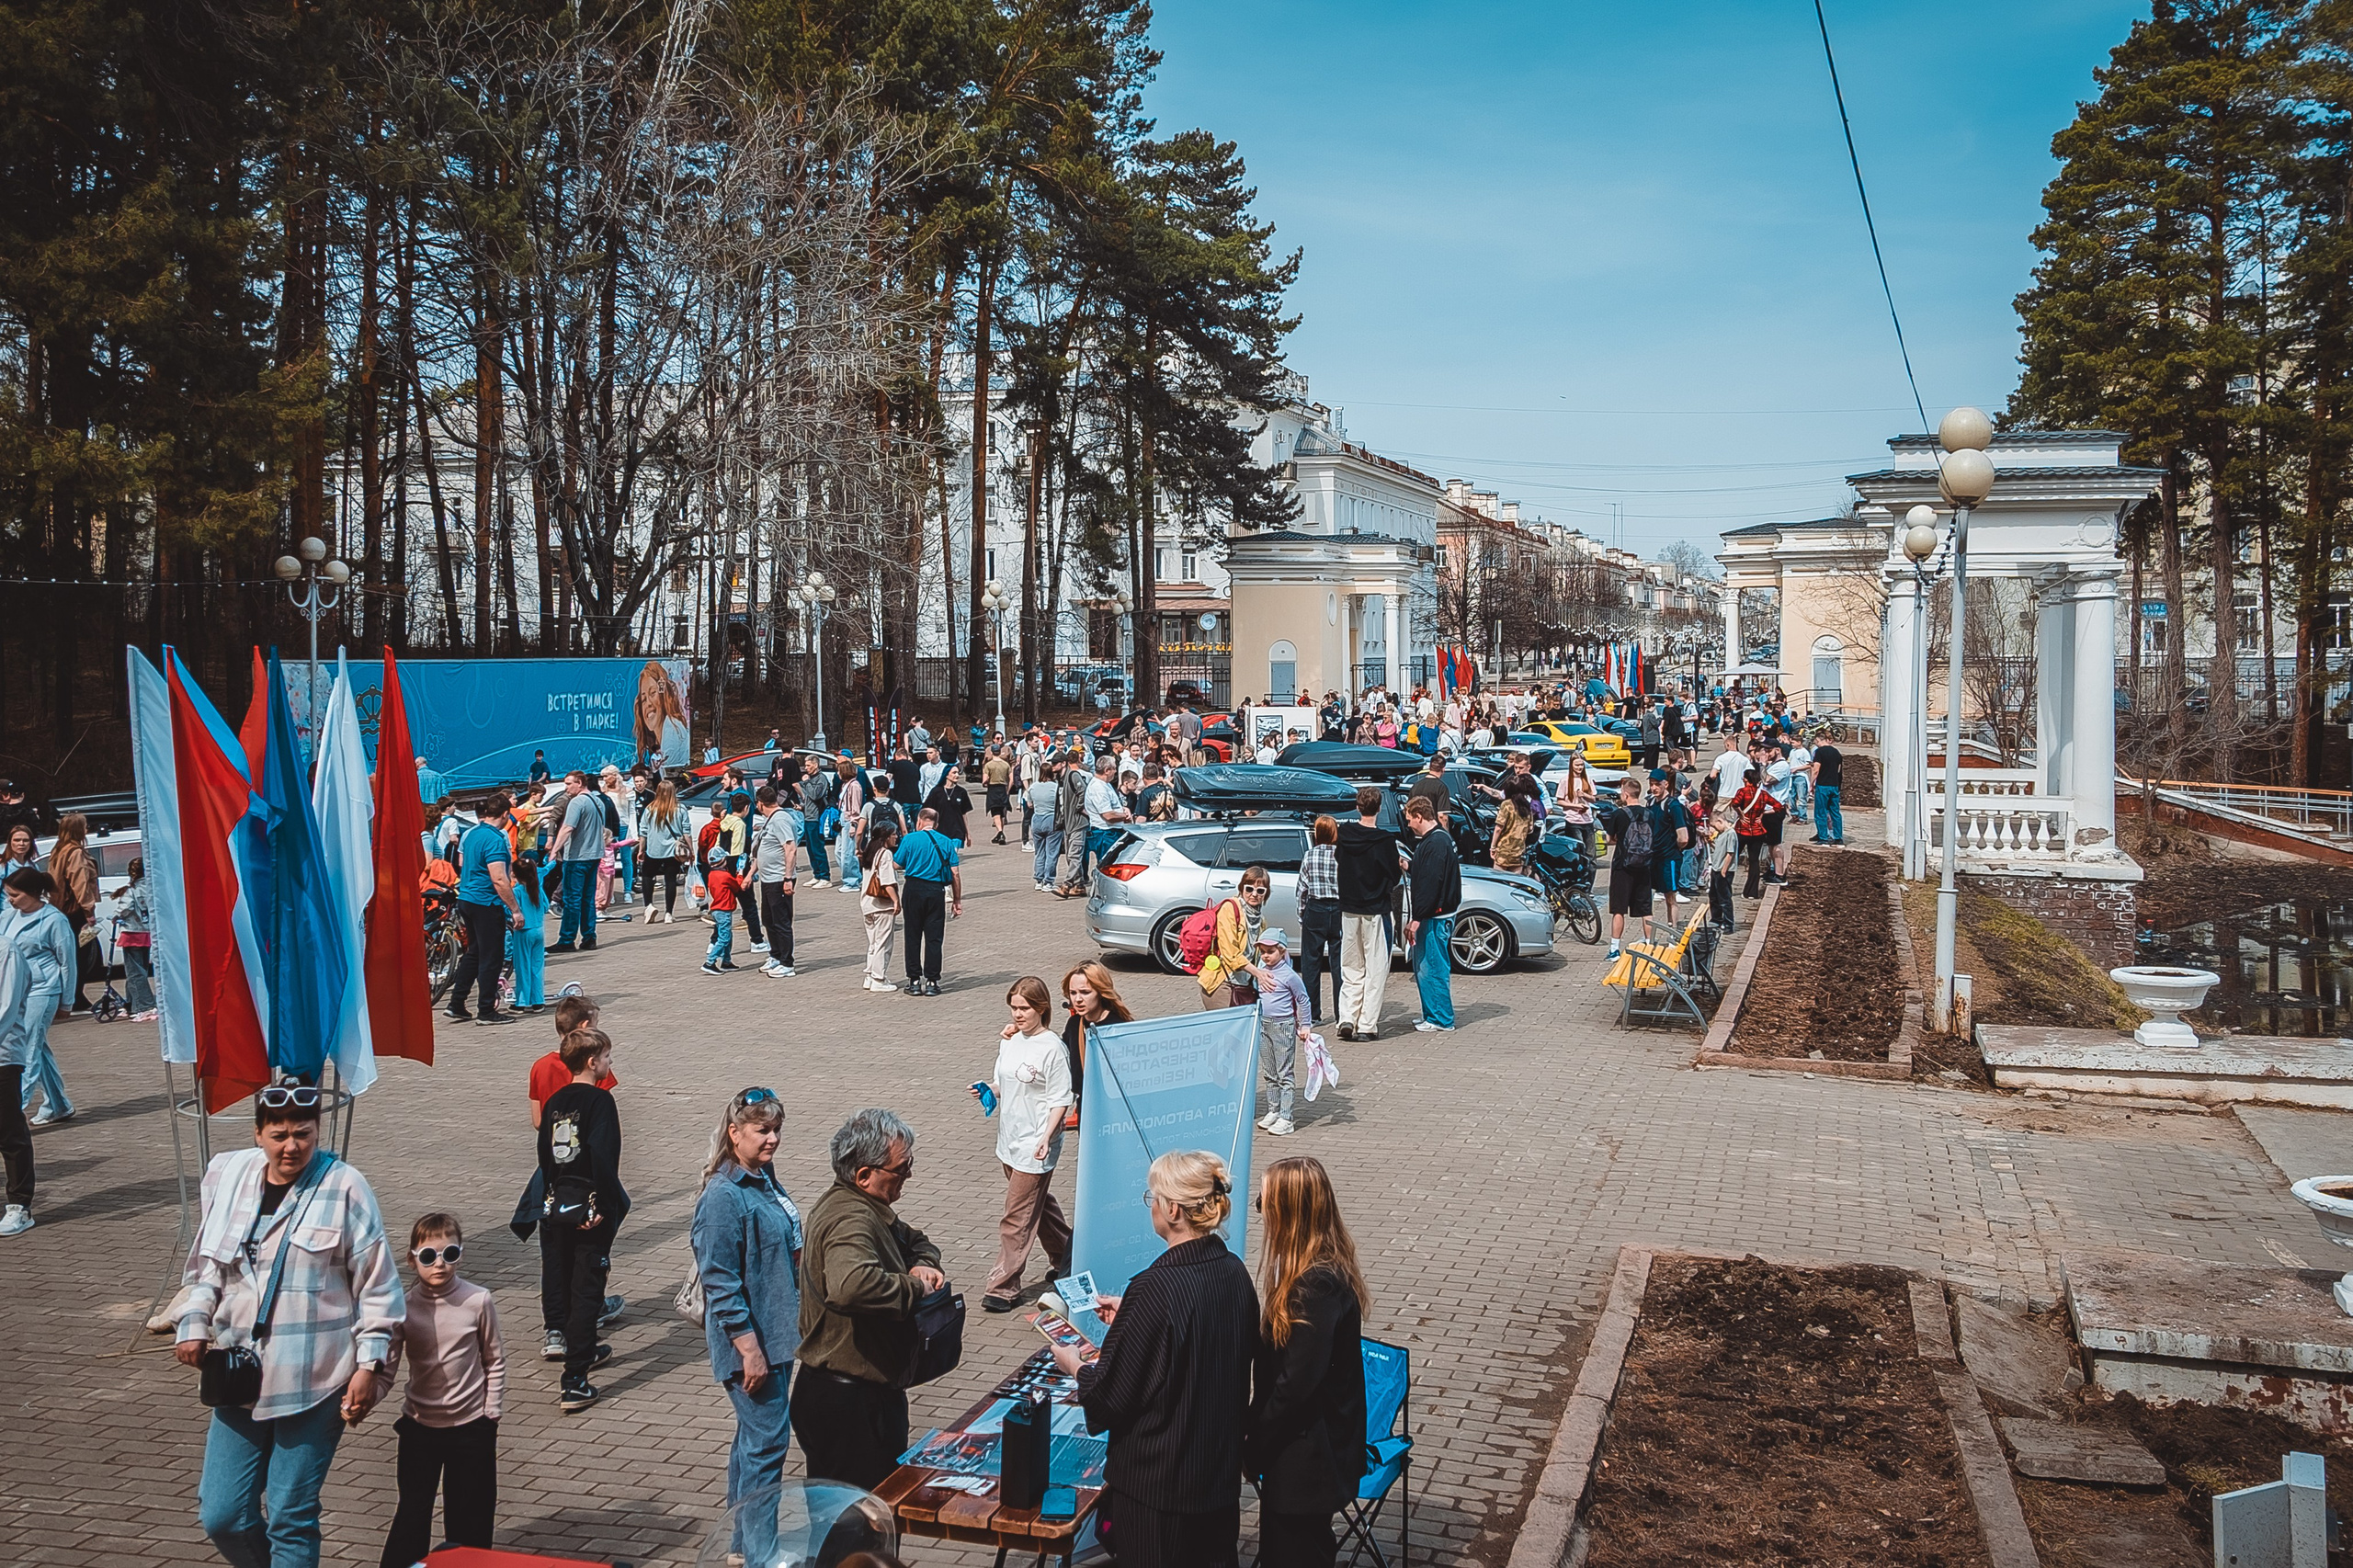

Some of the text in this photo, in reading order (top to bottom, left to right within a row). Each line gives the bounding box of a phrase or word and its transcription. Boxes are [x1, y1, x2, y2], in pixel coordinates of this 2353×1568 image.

[548, 691, 612, 712] ВСТРЕТИМСЯ
[574, 711, 620, 733] В ПАРКЕ!
[868, 706, 877, 769] ЕКТОР
